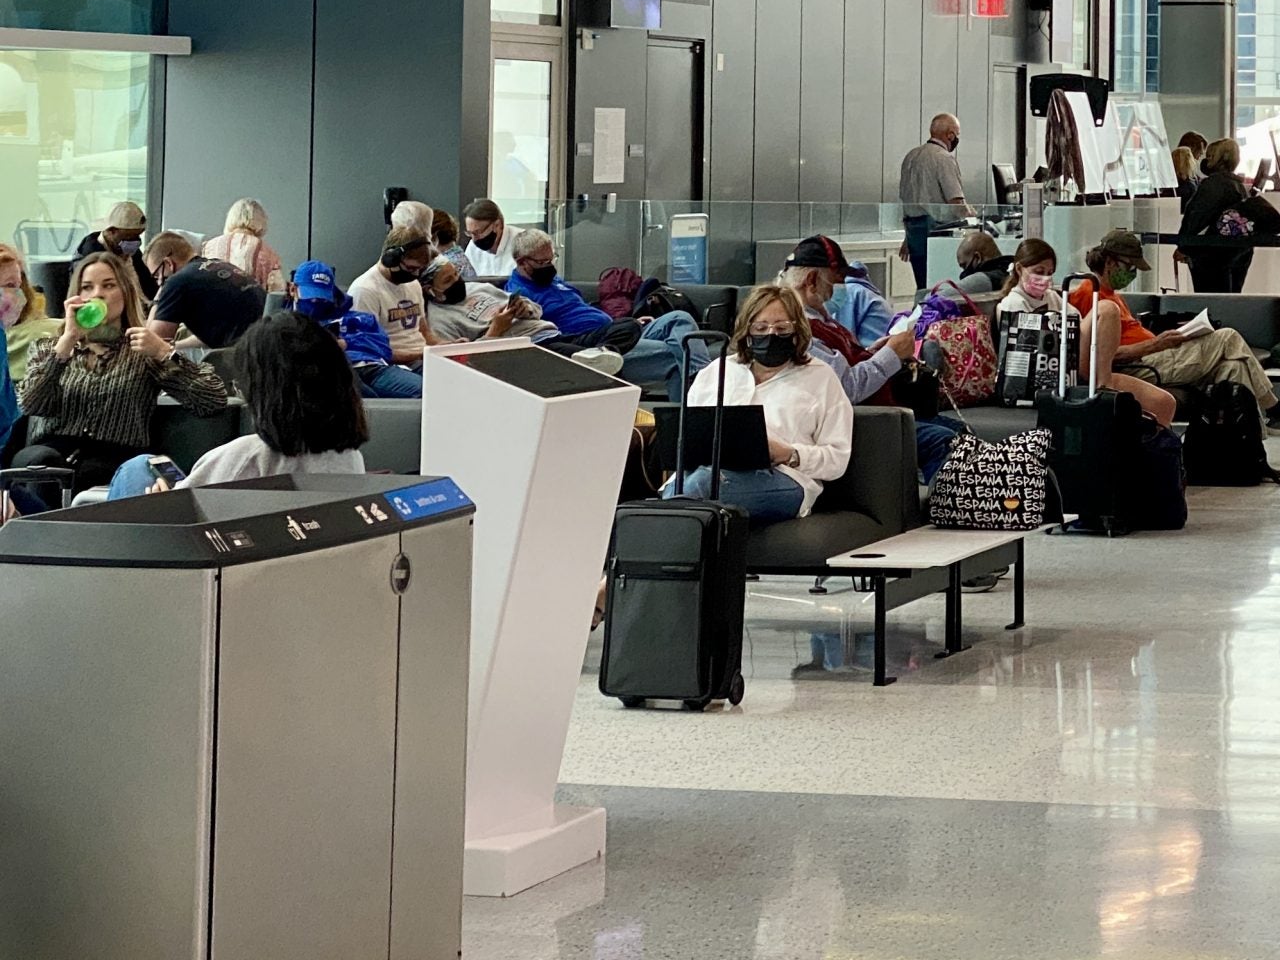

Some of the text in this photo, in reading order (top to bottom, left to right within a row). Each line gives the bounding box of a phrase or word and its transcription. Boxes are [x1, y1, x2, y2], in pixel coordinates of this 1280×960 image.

[977, 462, 1024, 475] ESPAÑA
[958, 473, 1003, 486] ESPAÑA
[935, 482, 972, 498] ESPAÑA
[975, 486, 1021, 500] ESPAÑA
[955, 497, 1002, 511] ESPAÑA
[930, 506, 973, 521] ESPAÑA
[974, 511, 1020, 524] ESPAÑA
